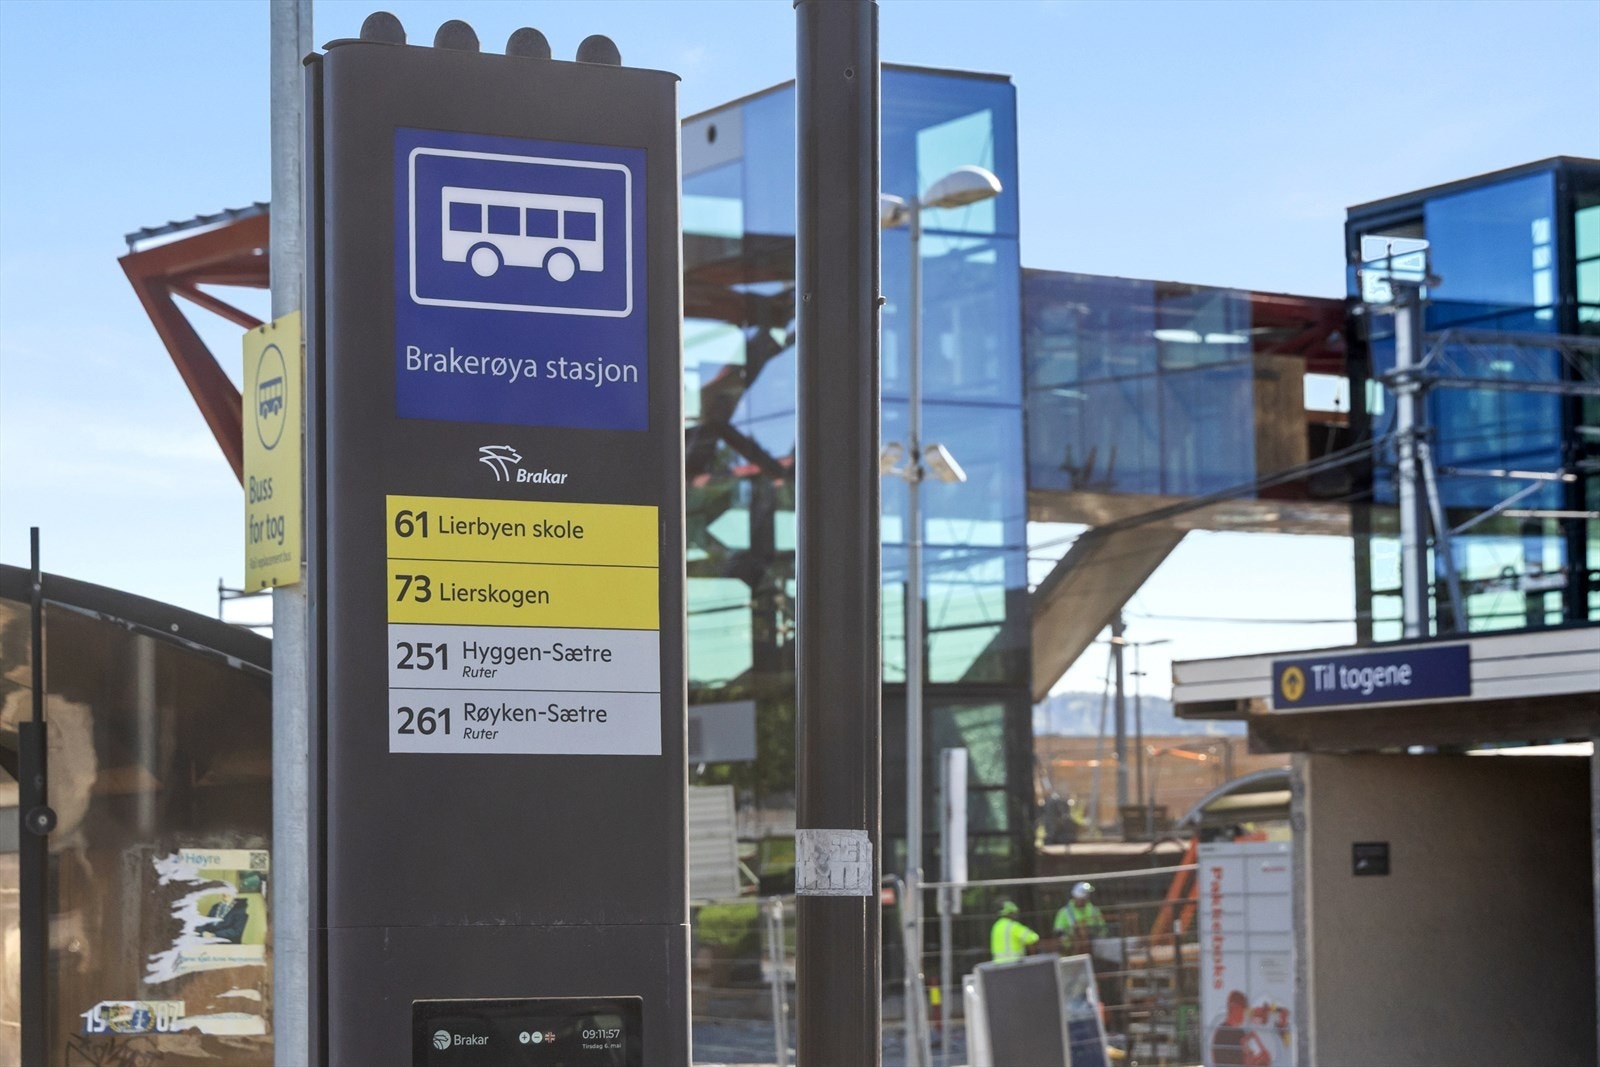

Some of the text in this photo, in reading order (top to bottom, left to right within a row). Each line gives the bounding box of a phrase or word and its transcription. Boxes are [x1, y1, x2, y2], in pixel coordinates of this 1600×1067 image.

[405, 345, 638, 388] Brakerøya stasjon
[249, 475, 273, 504] Buss
[516, 468, 568, 484] Brakar
[249, 513, 285, 546] for tog
[394, 510, 585, 540] 61 Lierbyen skole
[395, 574, 550, 607] 73 Lierskogen
[396, 641, 612, 670] 251 Hyggen-Sætre
[462, 666, 497, 678] Ruter
[1311, 663, 1413, 696] Til togene
[397, 702, 607, 735] 261 Røyken-Sætre
[463, 728, 498, 740] Ruter
[185, 853, 222, 867] Høyre
[453, 1034, 489, 1046] Brakar
[582, 1029, 621, 1039] 09:11:57
